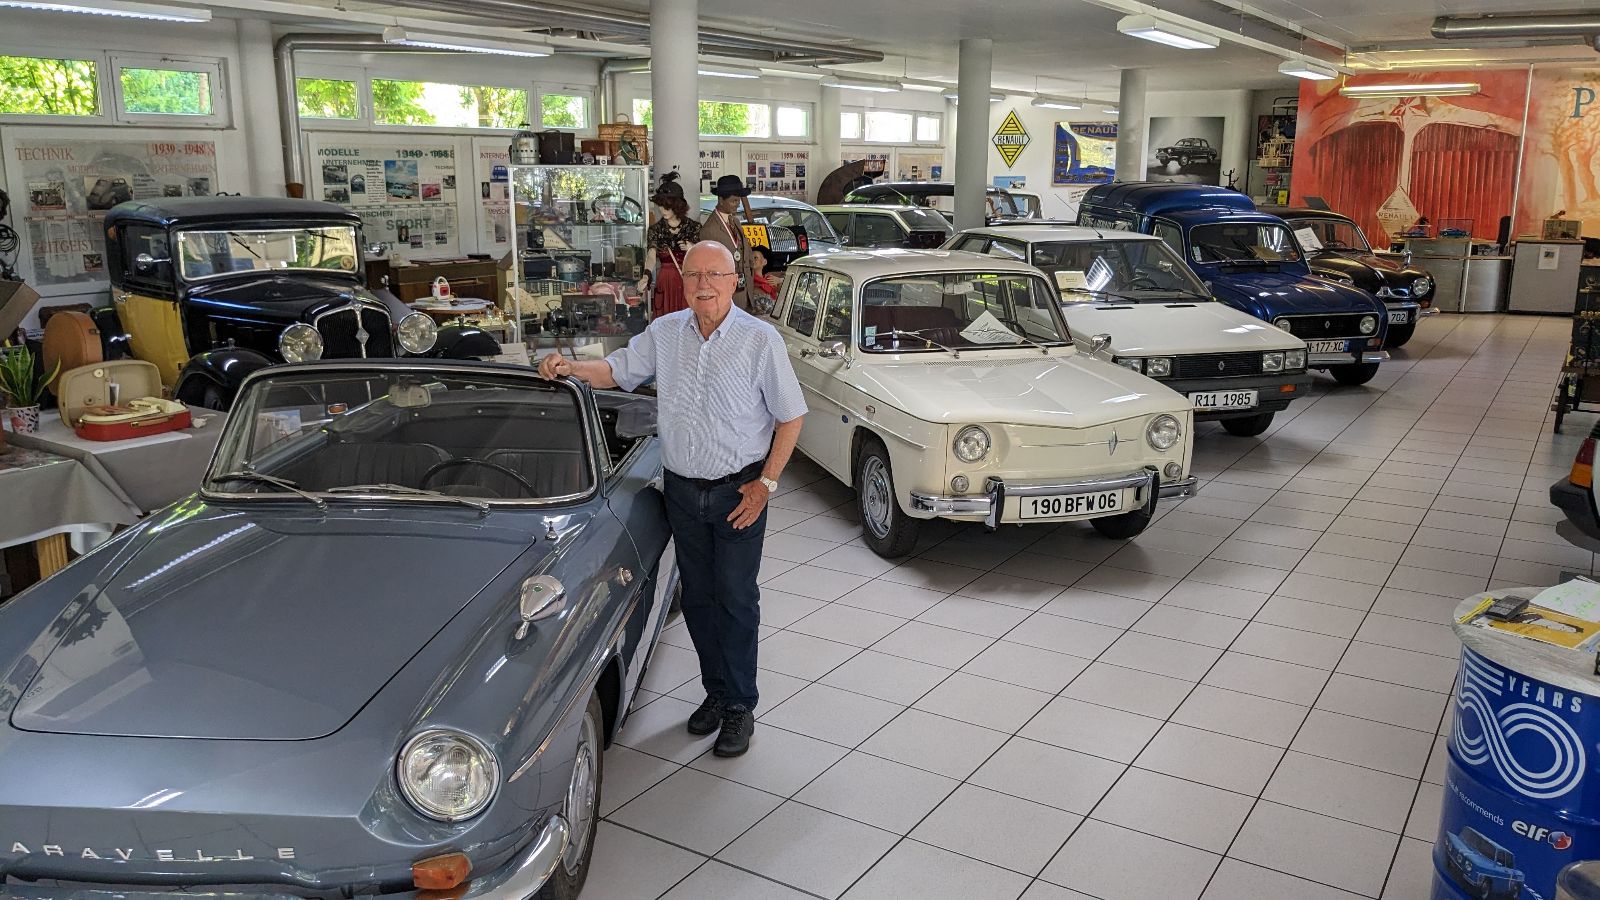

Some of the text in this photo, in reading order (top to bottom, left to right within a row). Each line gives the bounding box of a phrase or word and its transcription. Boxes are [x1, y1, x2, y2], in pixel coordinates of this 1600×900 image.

[1569, 87, 1596, 118] P
[1072, 126, 1118, 135] RENAUL
[997, 135, 1026, 144] RENAULT
[15, 147, 75, 161] TECHNIK
[154, 143, 176, 155] 1939
[699, 161, 719, 169] ODELLE
[386, 218, 432, 231] SPORT
[1390, 313, 1407, 323] 702
[1194, 391, 1252, 407] R11 1985
[1031, 492, 1118, 515] 190 BFW 06
[1508, 675, 1583, 713] YEARS
[1459, 790, 1504, 826] recommends
[1511, 819, 1549, 842] elf
[11, 841, 297, 862] ARAVELLE
